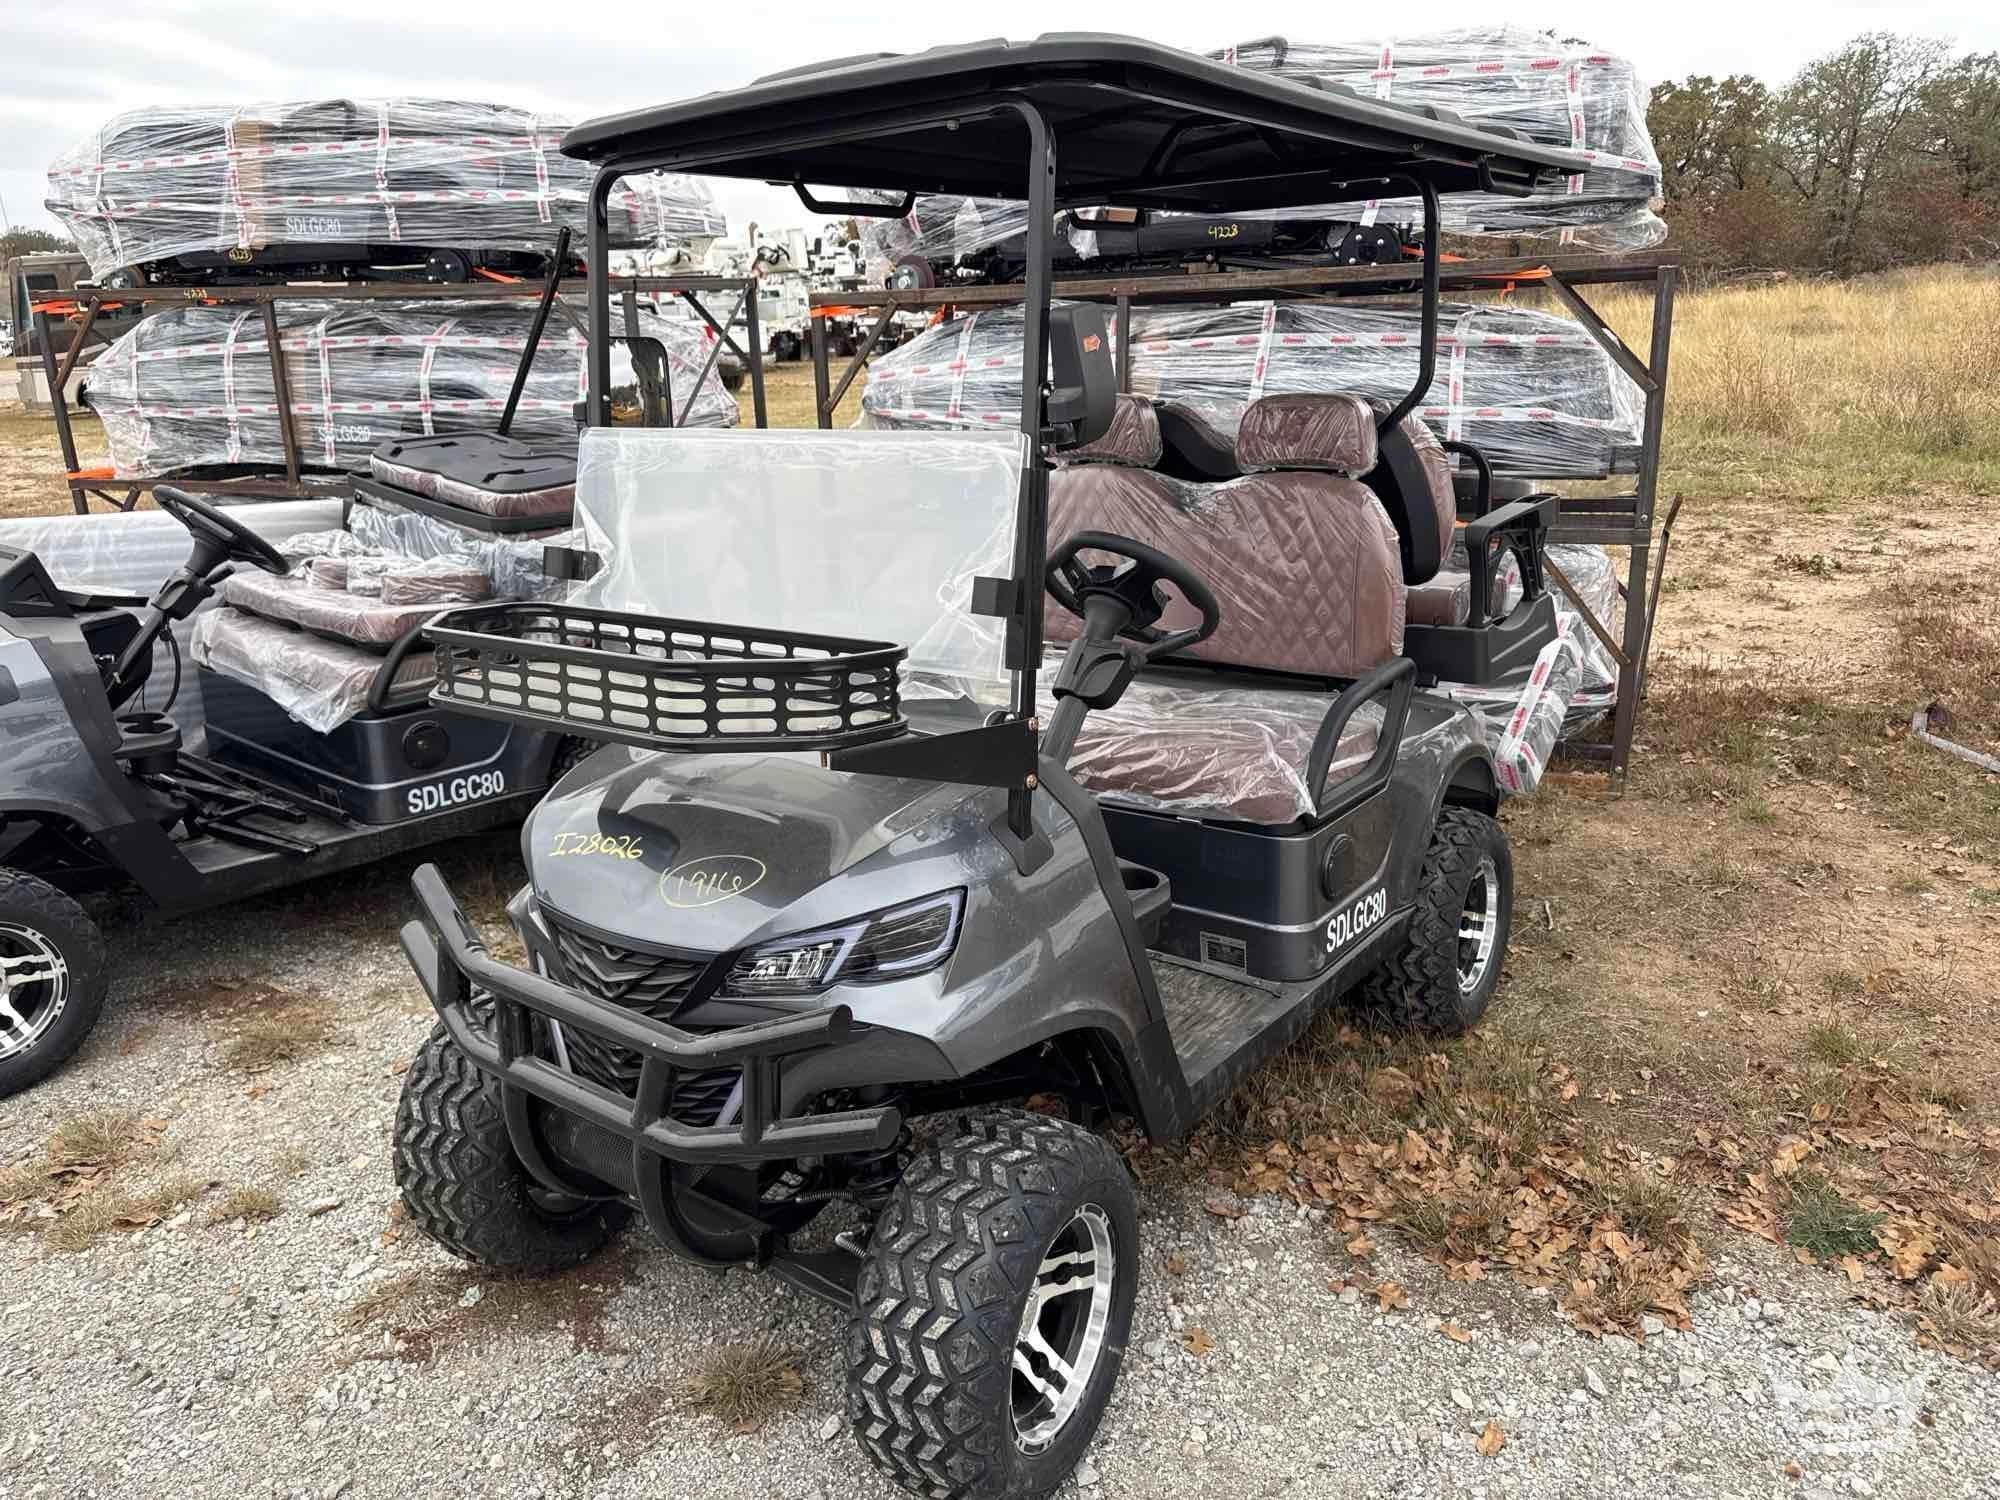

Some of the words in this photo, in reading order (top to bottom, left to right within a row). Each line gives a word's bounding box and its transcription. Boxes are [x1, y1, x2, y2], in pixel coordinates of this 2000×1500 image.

[407, 770, 505, 814] SDLGC80
[549, 832, 643, 860] I28026
[678, 870, 742, 896] 1916
[1326, 887, 1386, 953] SDLGC80
